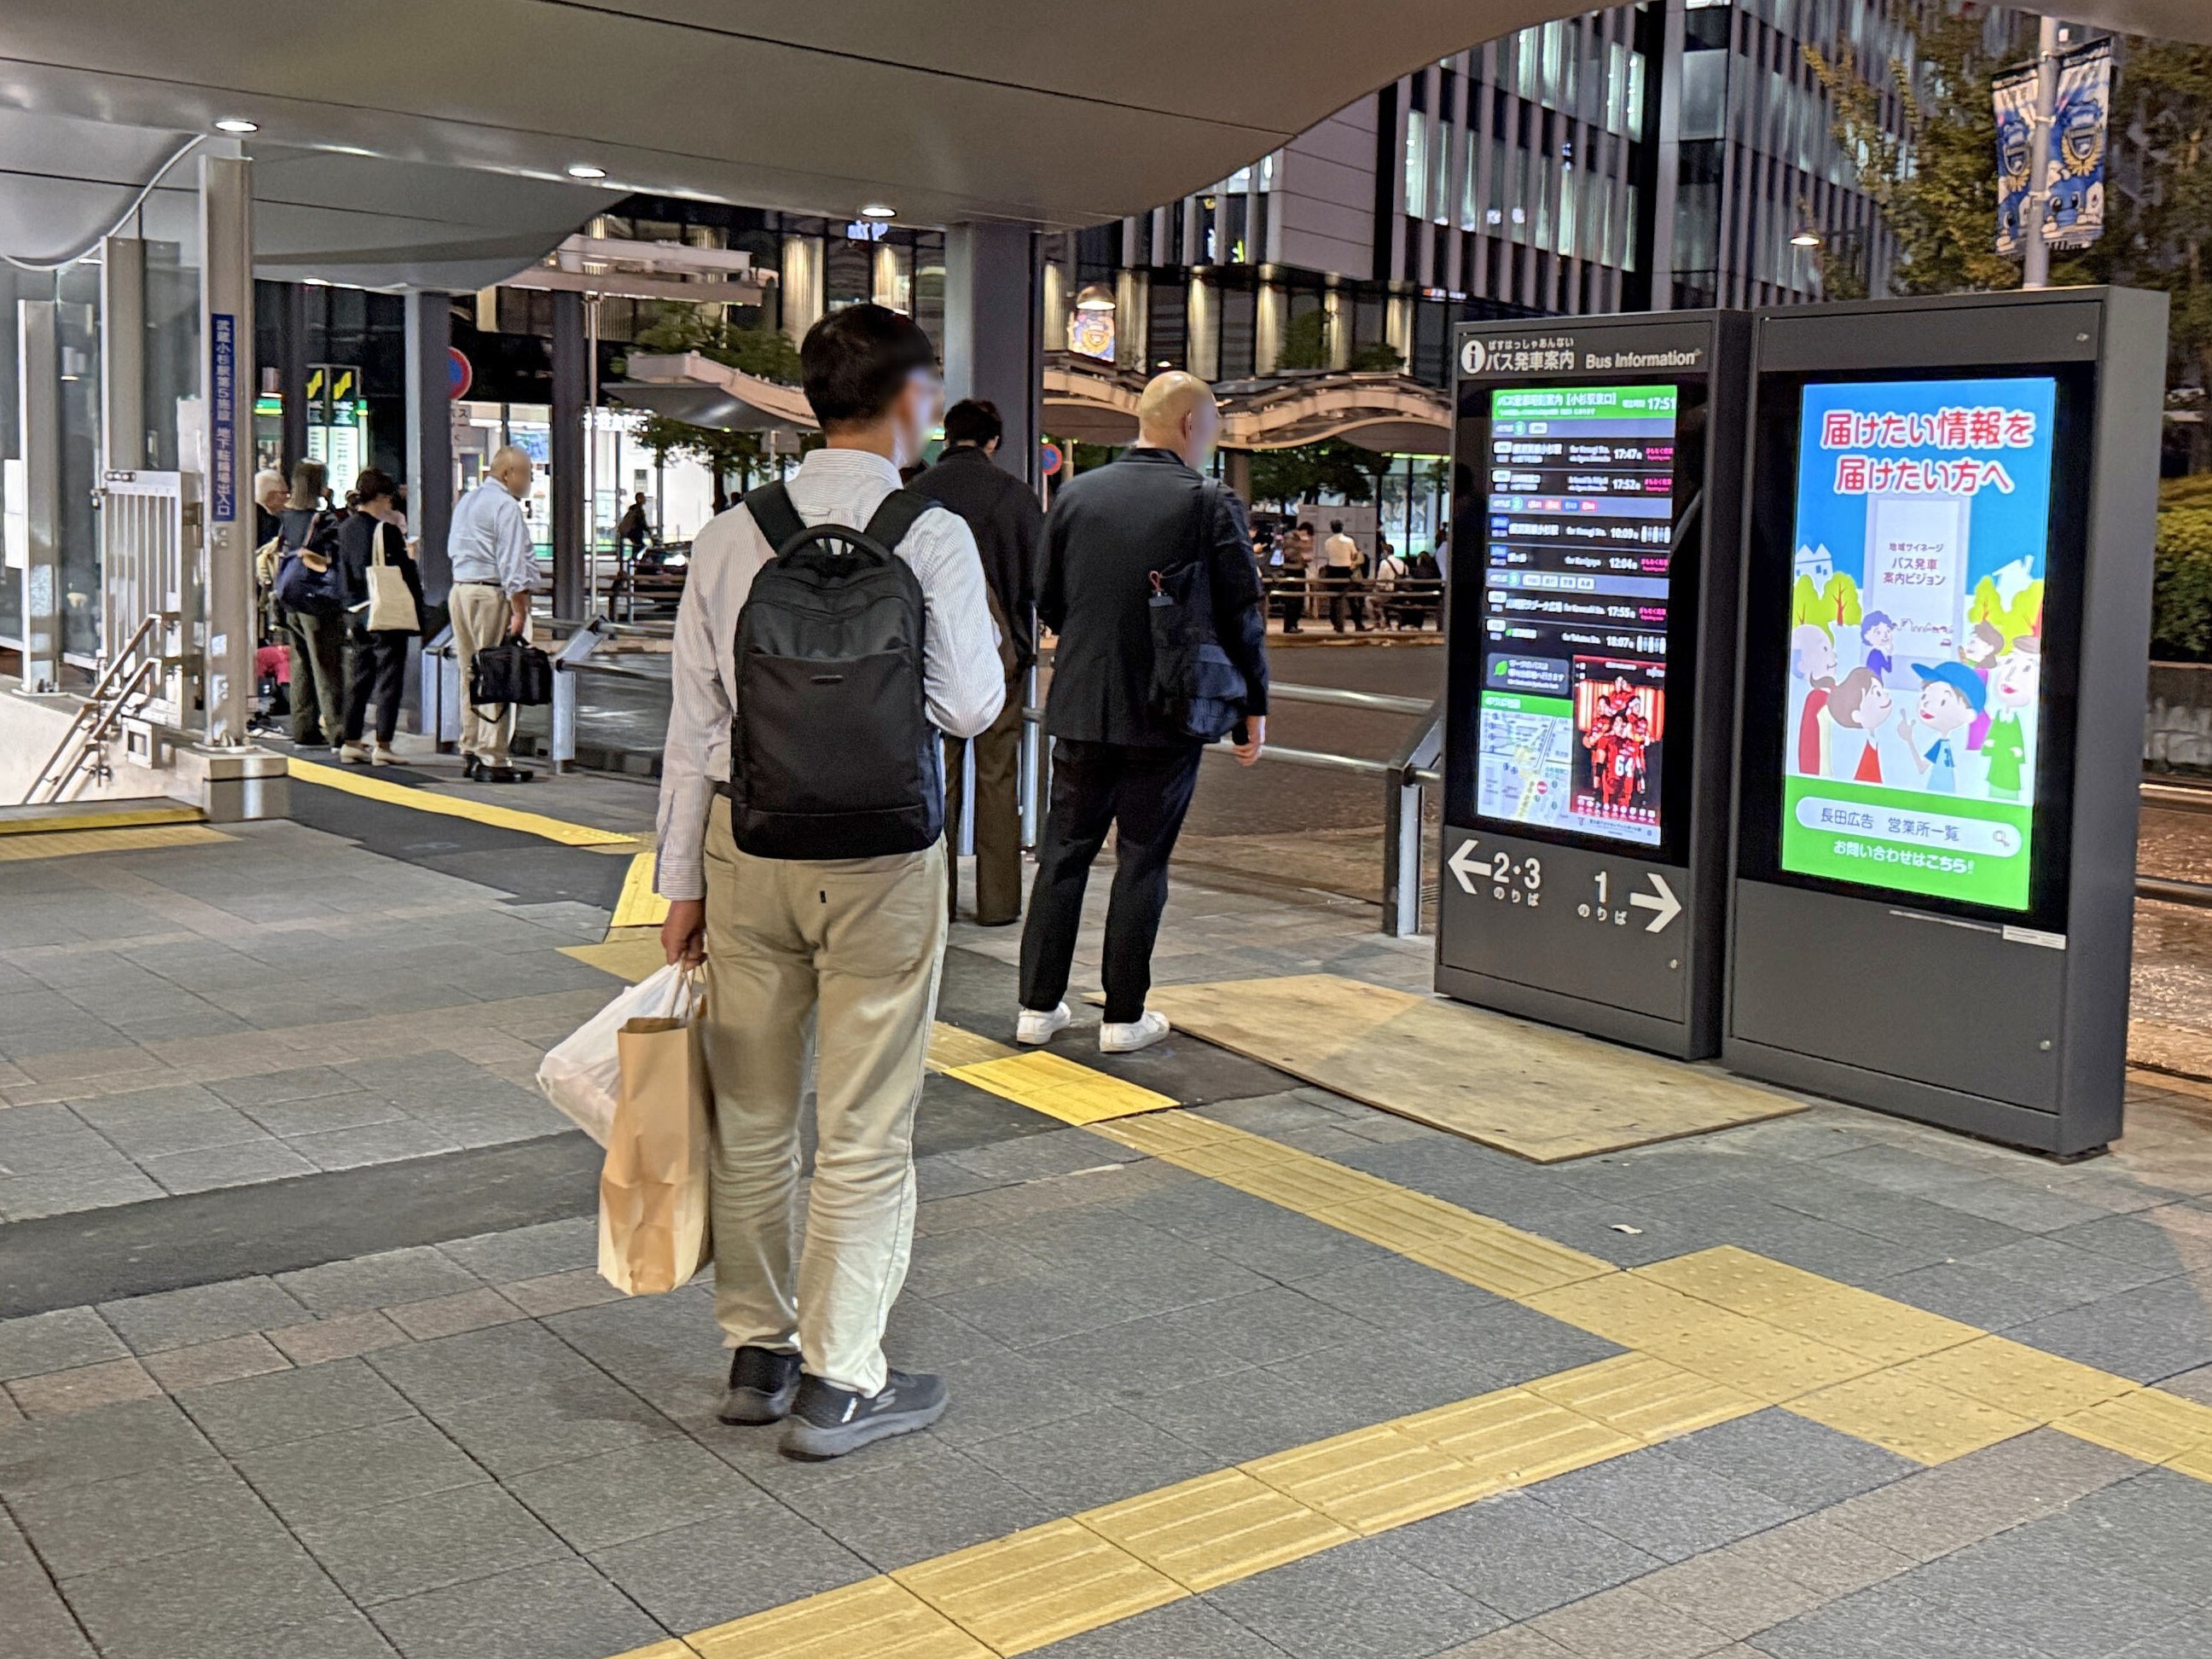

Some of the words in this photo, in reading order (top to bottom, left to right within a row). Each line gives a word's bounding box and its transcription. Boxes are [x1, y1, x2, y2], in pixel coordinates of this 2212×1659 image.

[1488, 337, 1574, 351] ばすはっしゃあんない
[1485, 351, 1575, 371] バス発車案内
[1585, 353, 1613, 369] Bus
[1615, 350, 1696, 368] Information
[1647, 397, 1675, 410] 17:51
[1822, 409, 2035, 447] 届けたい情報を
[1836, 456, 2012, 493] 届けたい方へ
[1889, 542, 1944, 554] 地域サイネージ
[1891, 558, 1938, 571] バス発車
[1884, 571, 1946, 586] 案内ビジョン
[1615, 754, 1634, 777] 64
[1820, 807, 1874, 830] 長田広告
[1888, 817, 1960, 843] 営業所一覧
[1493, 885, 1540, 907] のりば
[1594, 871, 1607, 903] 1
[1576, 902, 1628, 925] のりば
